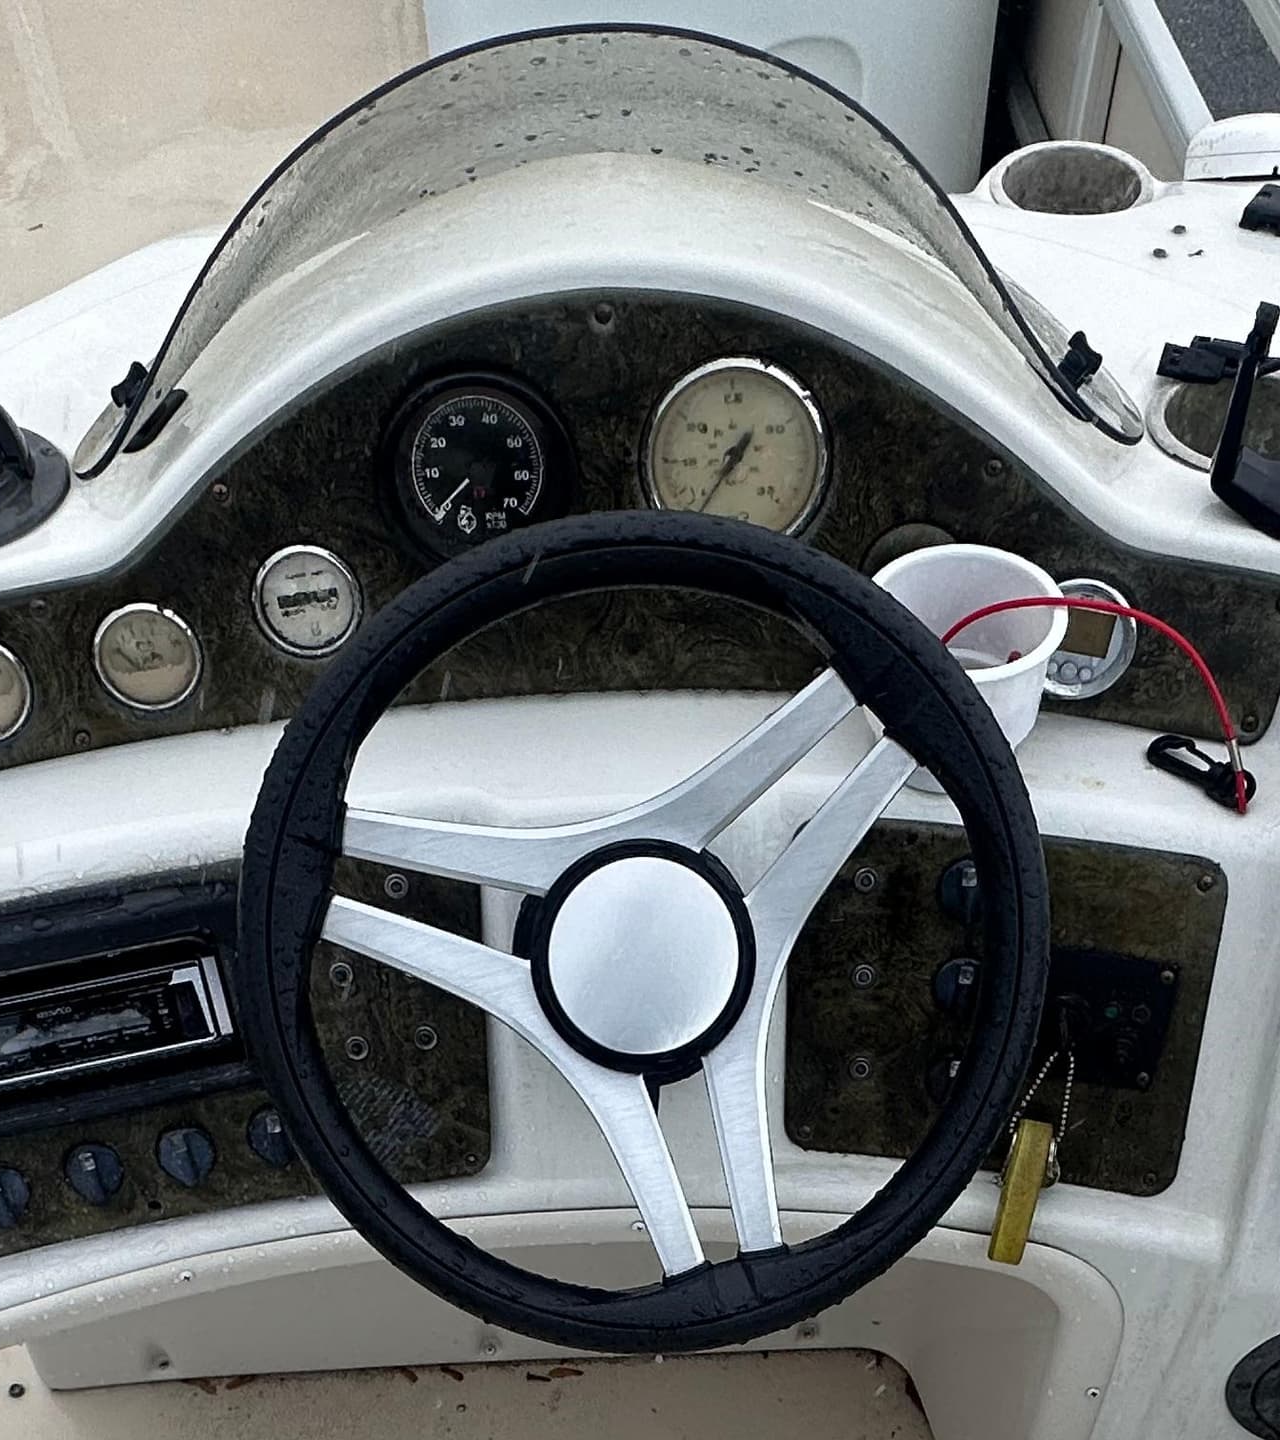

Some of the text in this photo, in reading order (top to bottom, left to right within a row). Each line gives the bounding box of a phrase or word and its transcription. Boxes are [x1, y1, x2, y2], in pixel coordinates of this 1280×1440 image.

[449, 415, 465, 426] 30
[430, 437, 446, 448] 20
[425, 467, 439, 478] 10
[503, 497, 517, 508] 70
